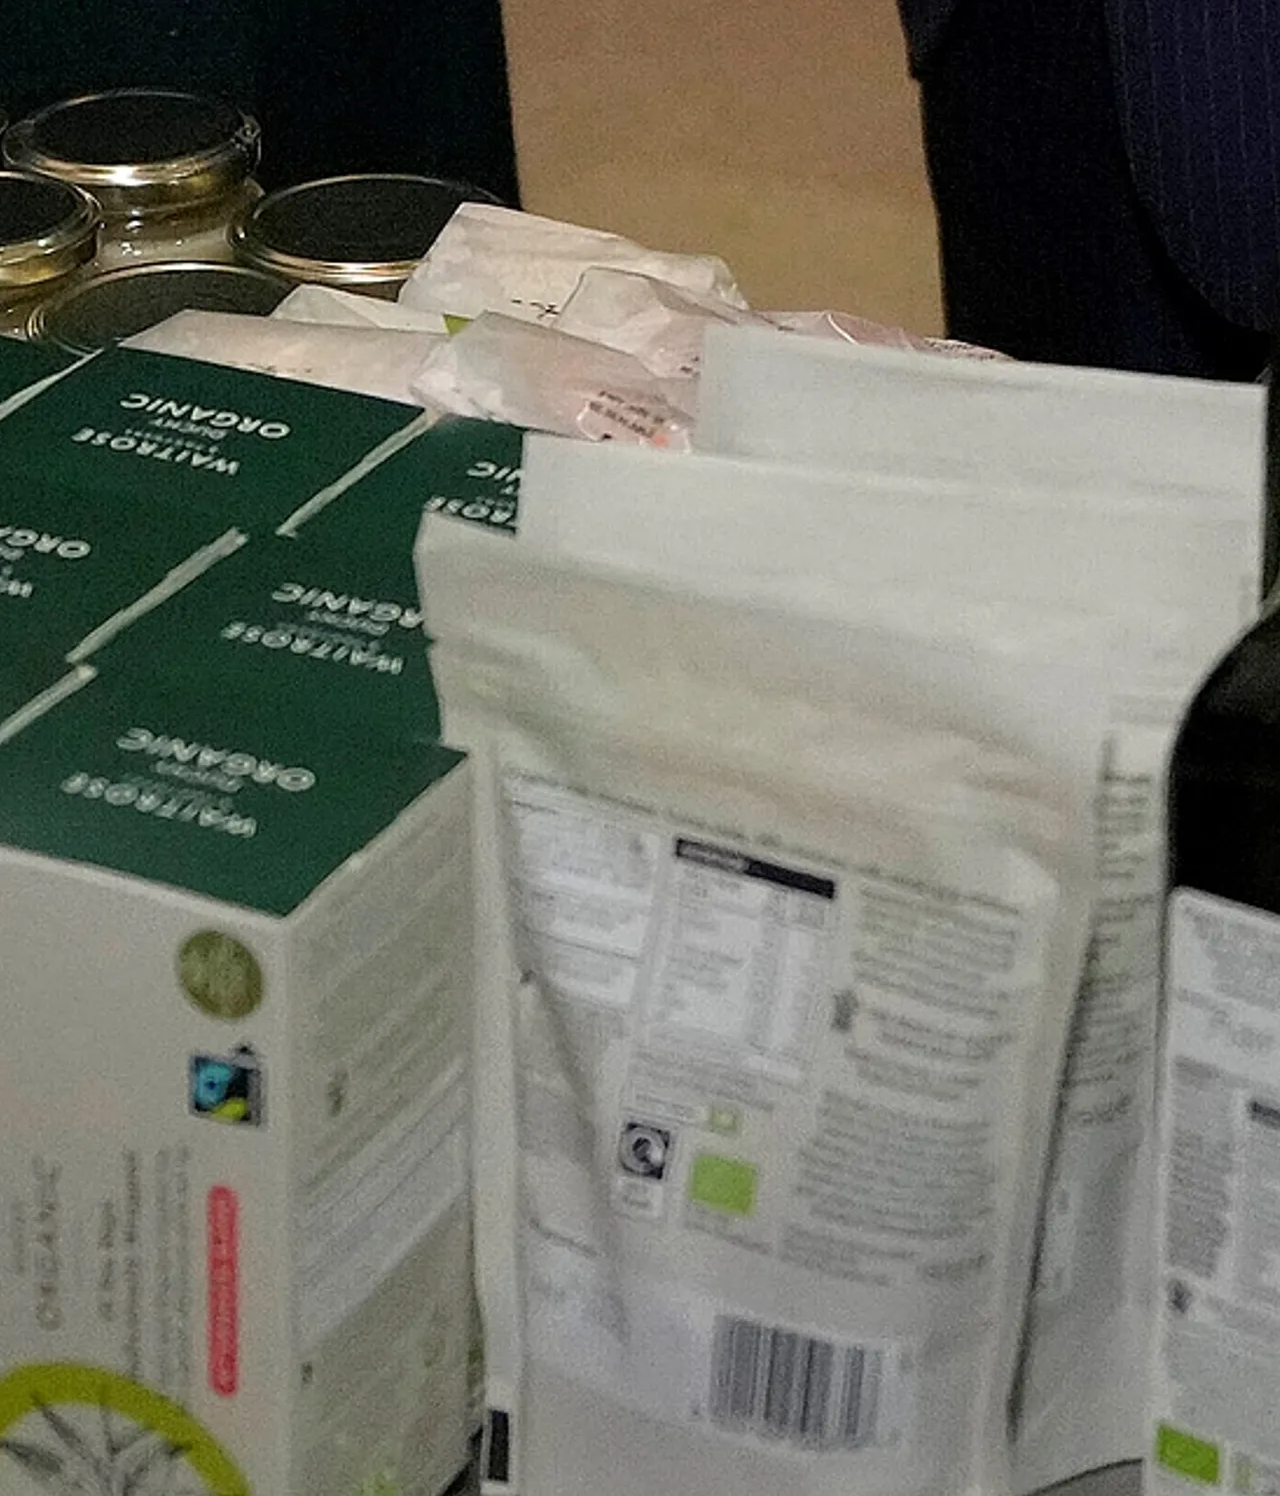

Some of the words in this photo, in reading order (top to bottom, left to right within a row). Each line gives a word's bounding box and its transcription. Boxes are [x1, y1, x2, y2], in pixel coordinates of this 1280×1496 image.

[120, 393, 290, 440] ORGANIC
[71, 426, 241, 476] WAITROSE
[272, 582, 423, 628] RGANIC
[222, 621, 403, 675] WAITROSE
[117, 728, 315, 792] ORGANIC
[60, 772, 257, 837] WAITROSE
